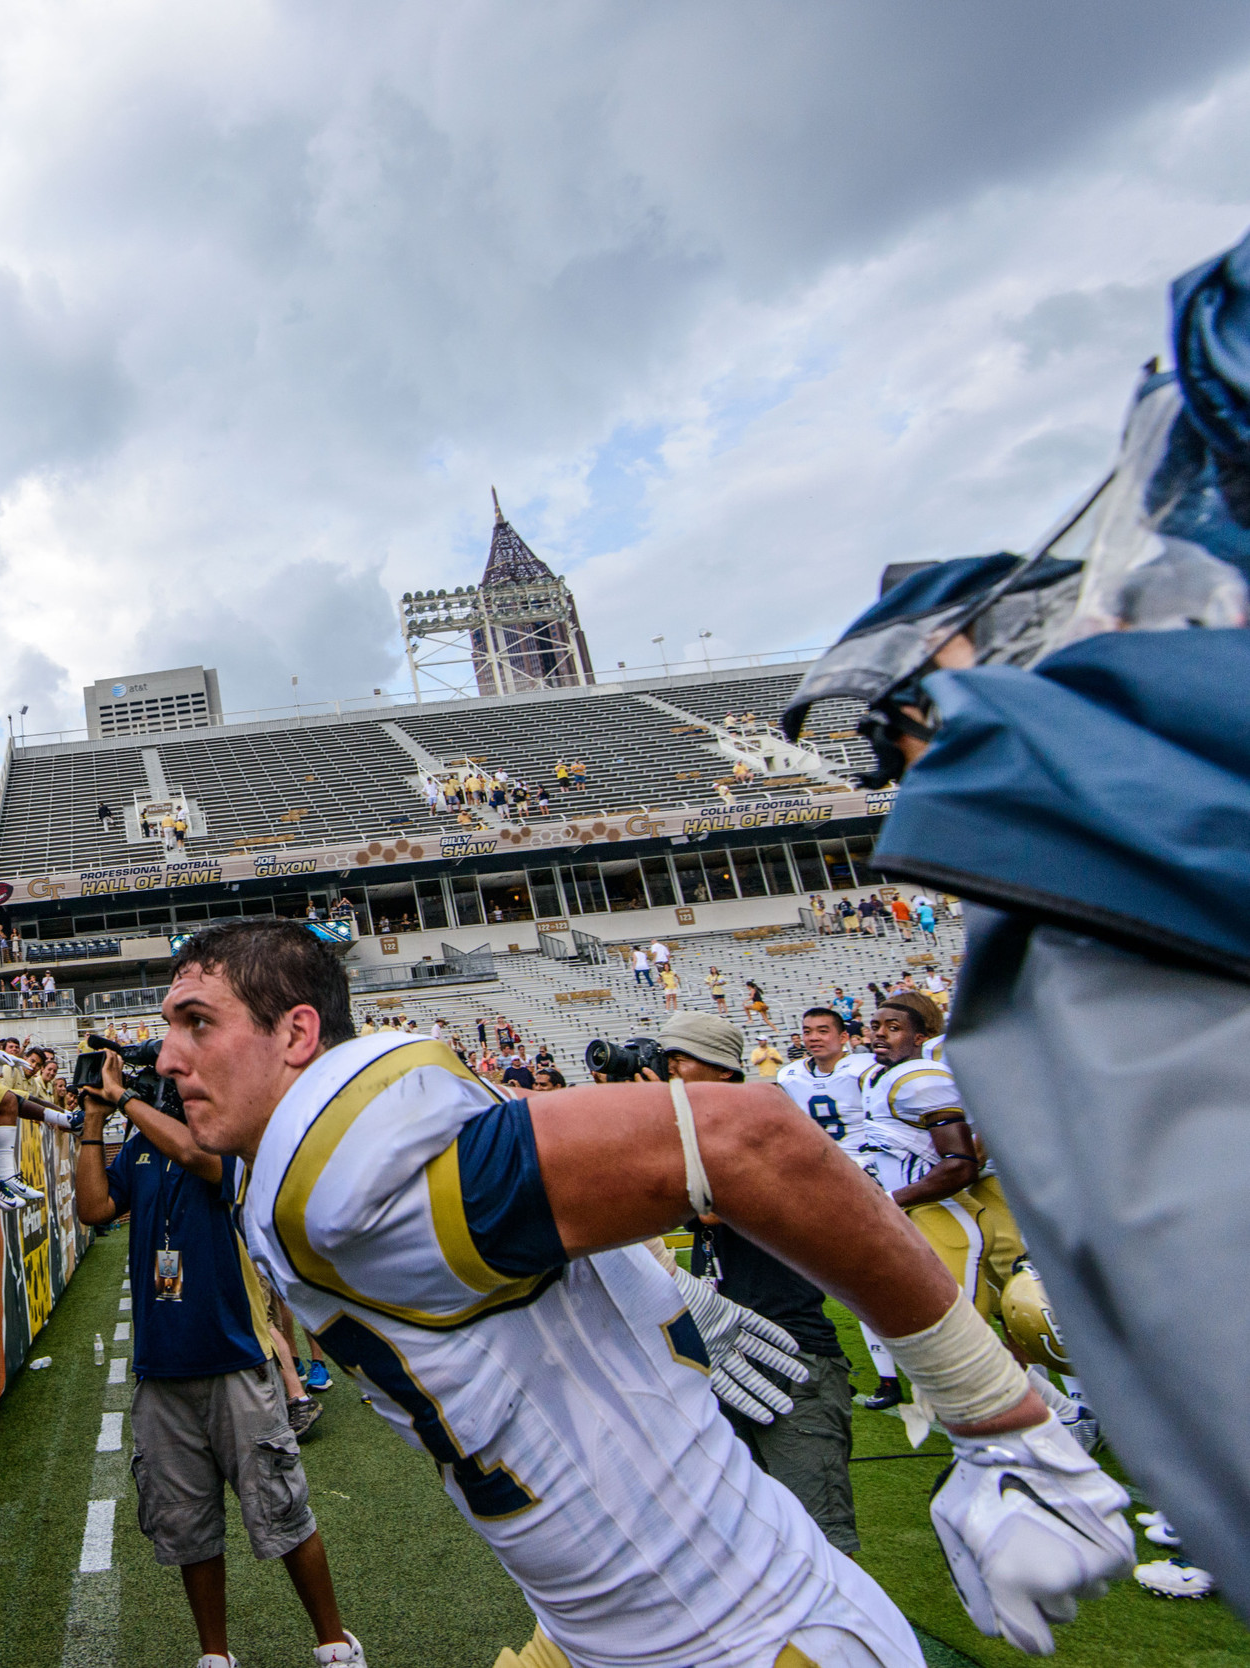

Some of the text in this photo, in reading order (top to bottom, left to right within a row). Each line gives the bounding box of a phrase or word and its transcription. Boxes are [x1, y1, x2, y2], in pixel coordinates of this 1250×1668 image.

[701, 798, 813, 816] COLLEGE FOOTBALL
[682, 804, 833, 835] HALL OF FAME
[439, 834, 472, 847] BILLY
[441, 840, 498, 858] SHAW
[253, 854, 277, 866] JOE
[255, 858, 318, 878] GUYON
[80, 859, 221, 881] PROFESSIONAL FOOTBALL
[80, 867, 223, 897] HALL OF FAME
